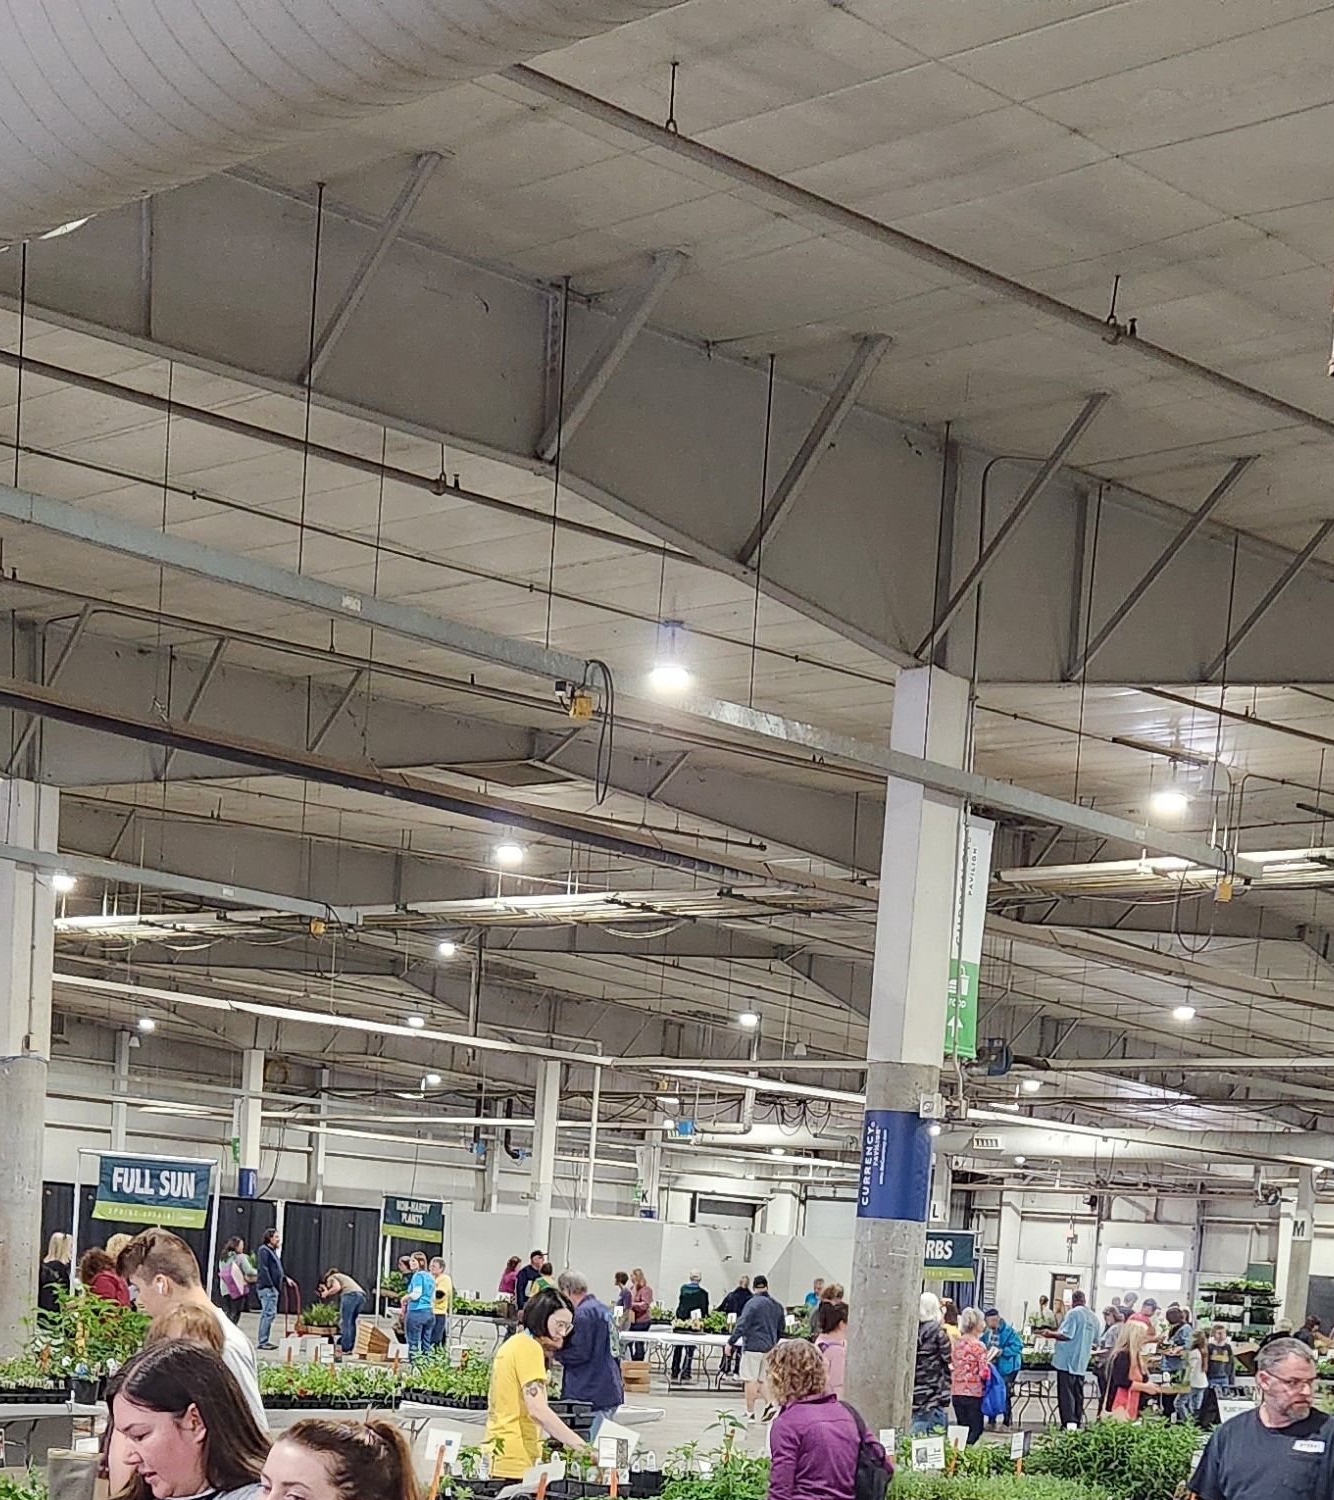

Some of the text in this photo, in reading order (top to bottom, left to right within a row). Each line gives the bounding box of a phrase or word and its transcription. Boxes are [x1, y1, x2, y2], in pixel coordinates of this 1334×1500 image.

[968, 847, 978, 896] PAVILION
[861, 1126, 875, 1206] CURRENCY
[112, 1167, 195, 1199] FULL SUN
[642, 1190, 648, 1203] K
[401, 1212, 423, 1226] PLANTS
[932, 1204, 939, 1218] L
[1292, 1220, 1305, 1236] M
[925, 1239, 953, 1261] RBS
